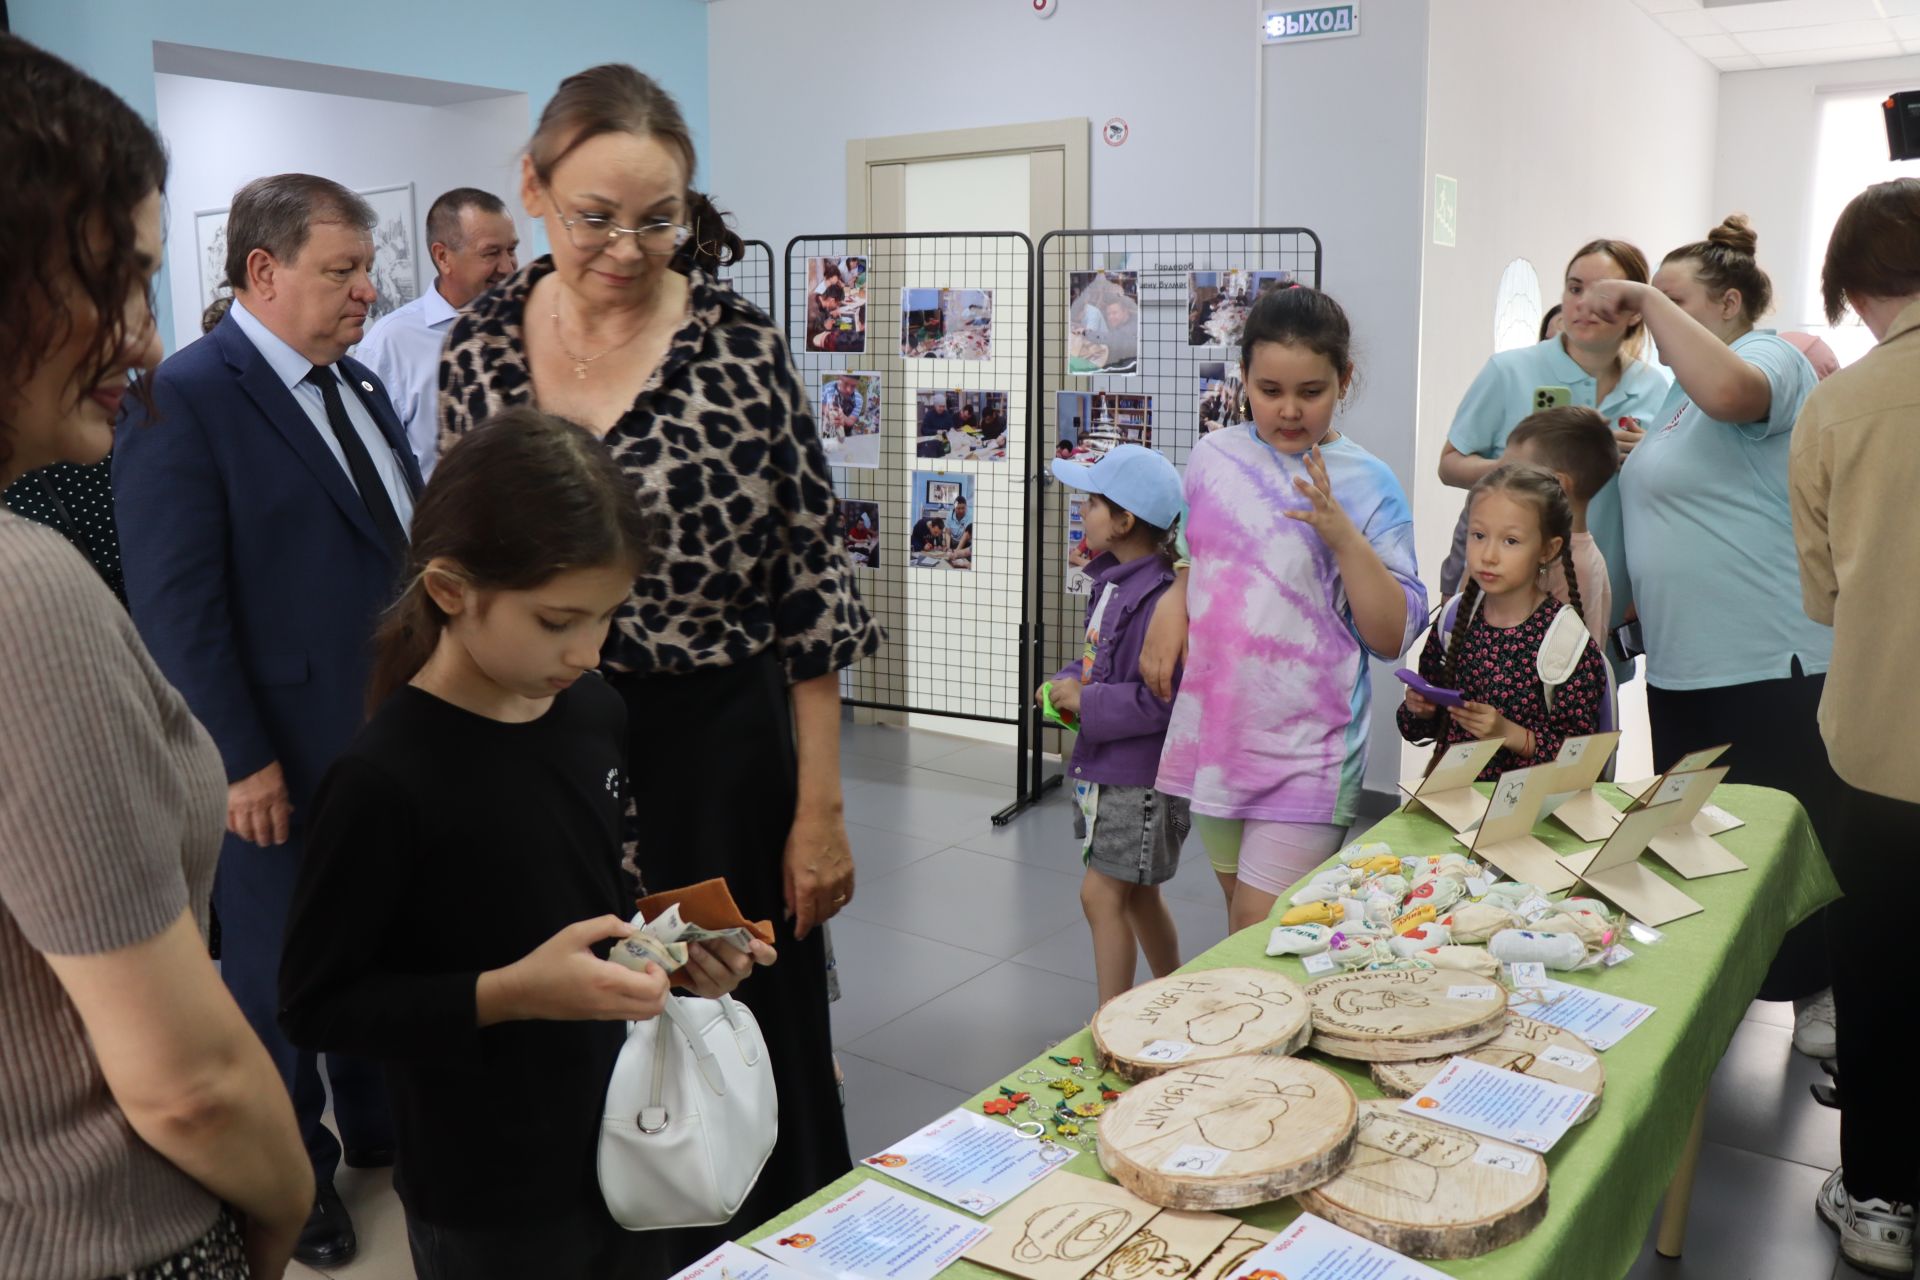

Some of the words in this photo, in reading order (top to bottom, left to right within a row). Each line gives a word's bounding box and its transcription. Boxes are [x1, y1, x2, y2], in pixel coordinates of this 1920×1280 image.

[1267, 9, 1350, 36] ВЫХОД
[1235, 981, 1292, 1006] Я
[1246, 1077, 1316, 1098] Я
[847, 1190, 866, 1202] цена
[1291, 1225, 1306, 1239] цена
[704, 1254, 725, 1267] цена
